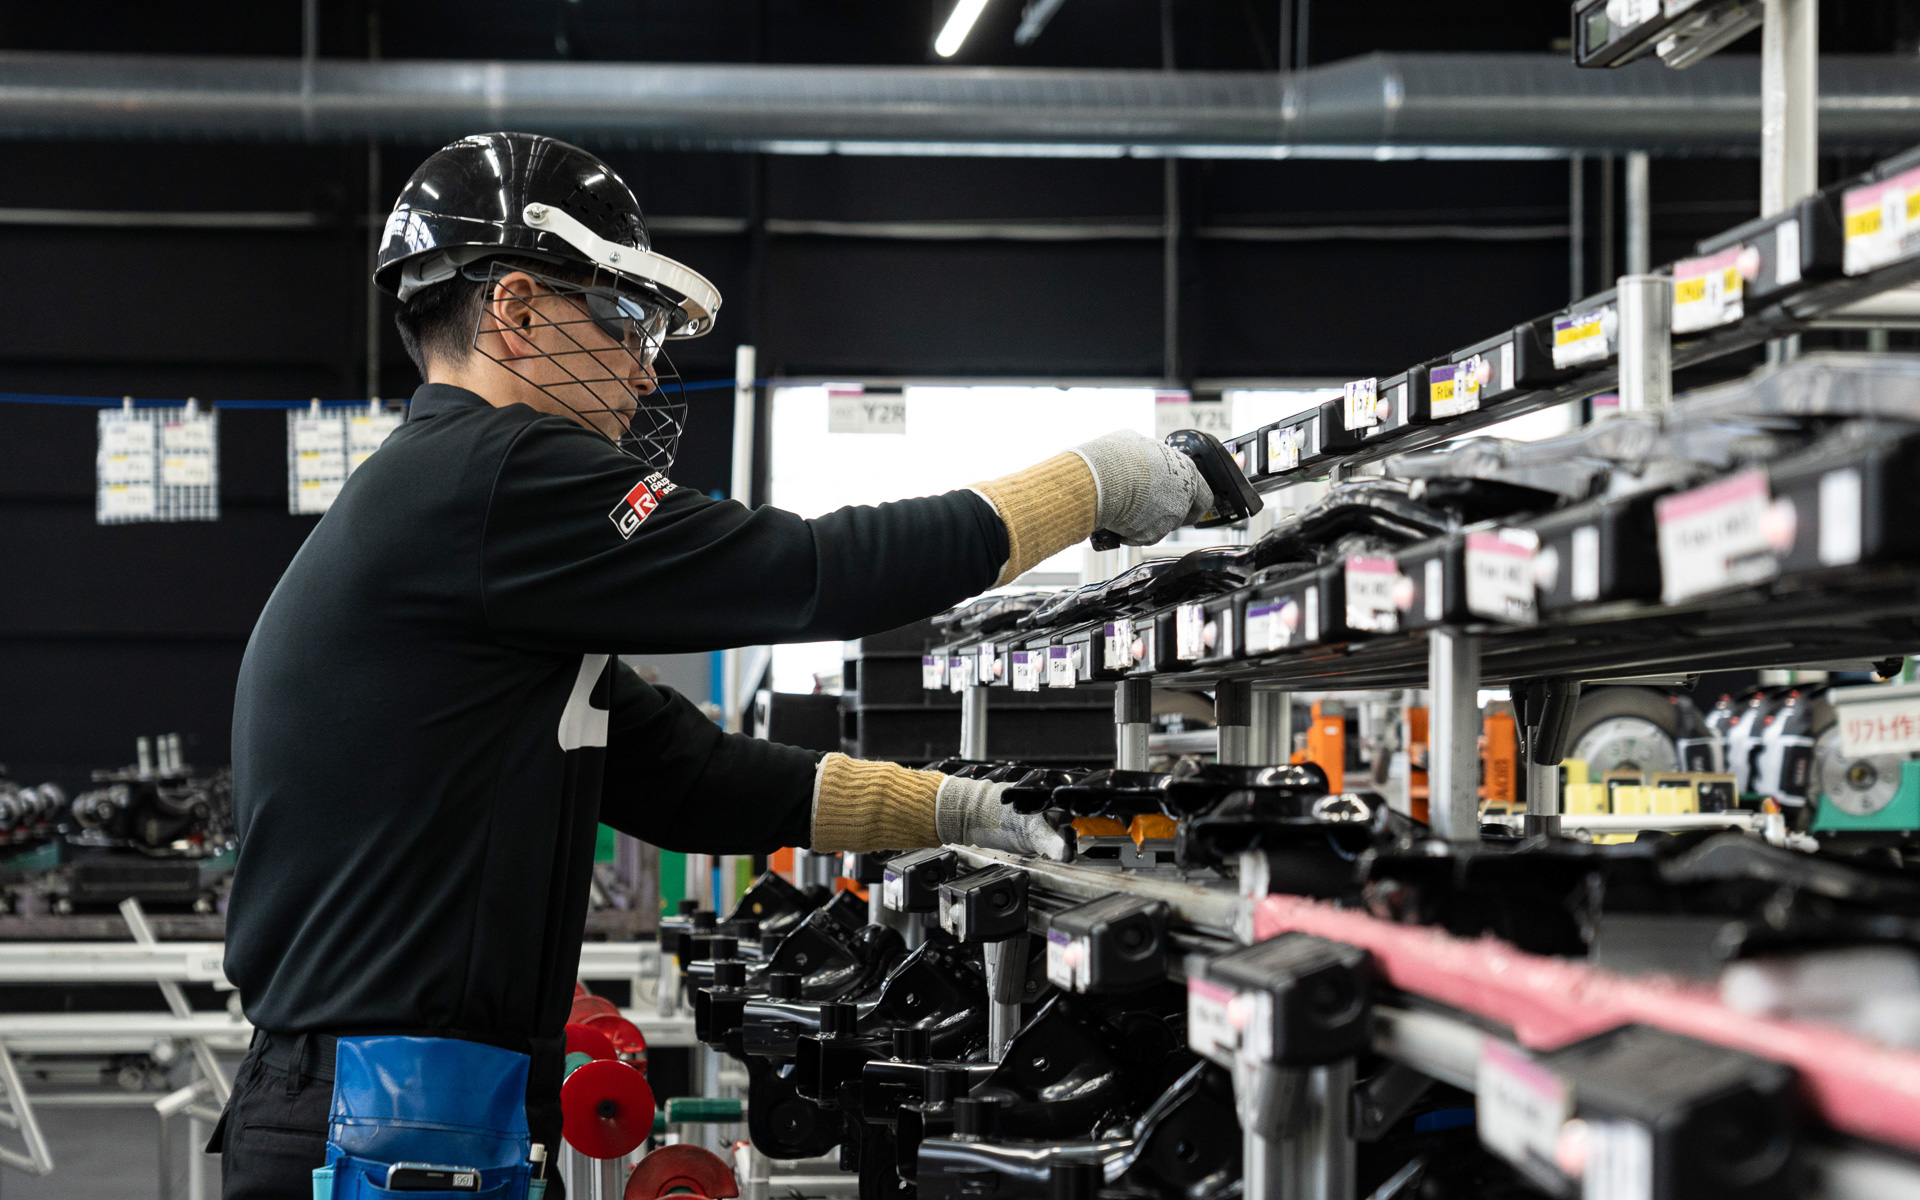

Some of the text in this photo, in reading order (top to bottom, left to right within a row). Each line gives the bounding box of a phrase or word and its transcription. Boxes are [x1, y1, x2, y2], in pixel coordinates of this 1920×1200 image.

[620, 493, 656, 534] GR
[1848, 713, 1920, 744] リフト作
